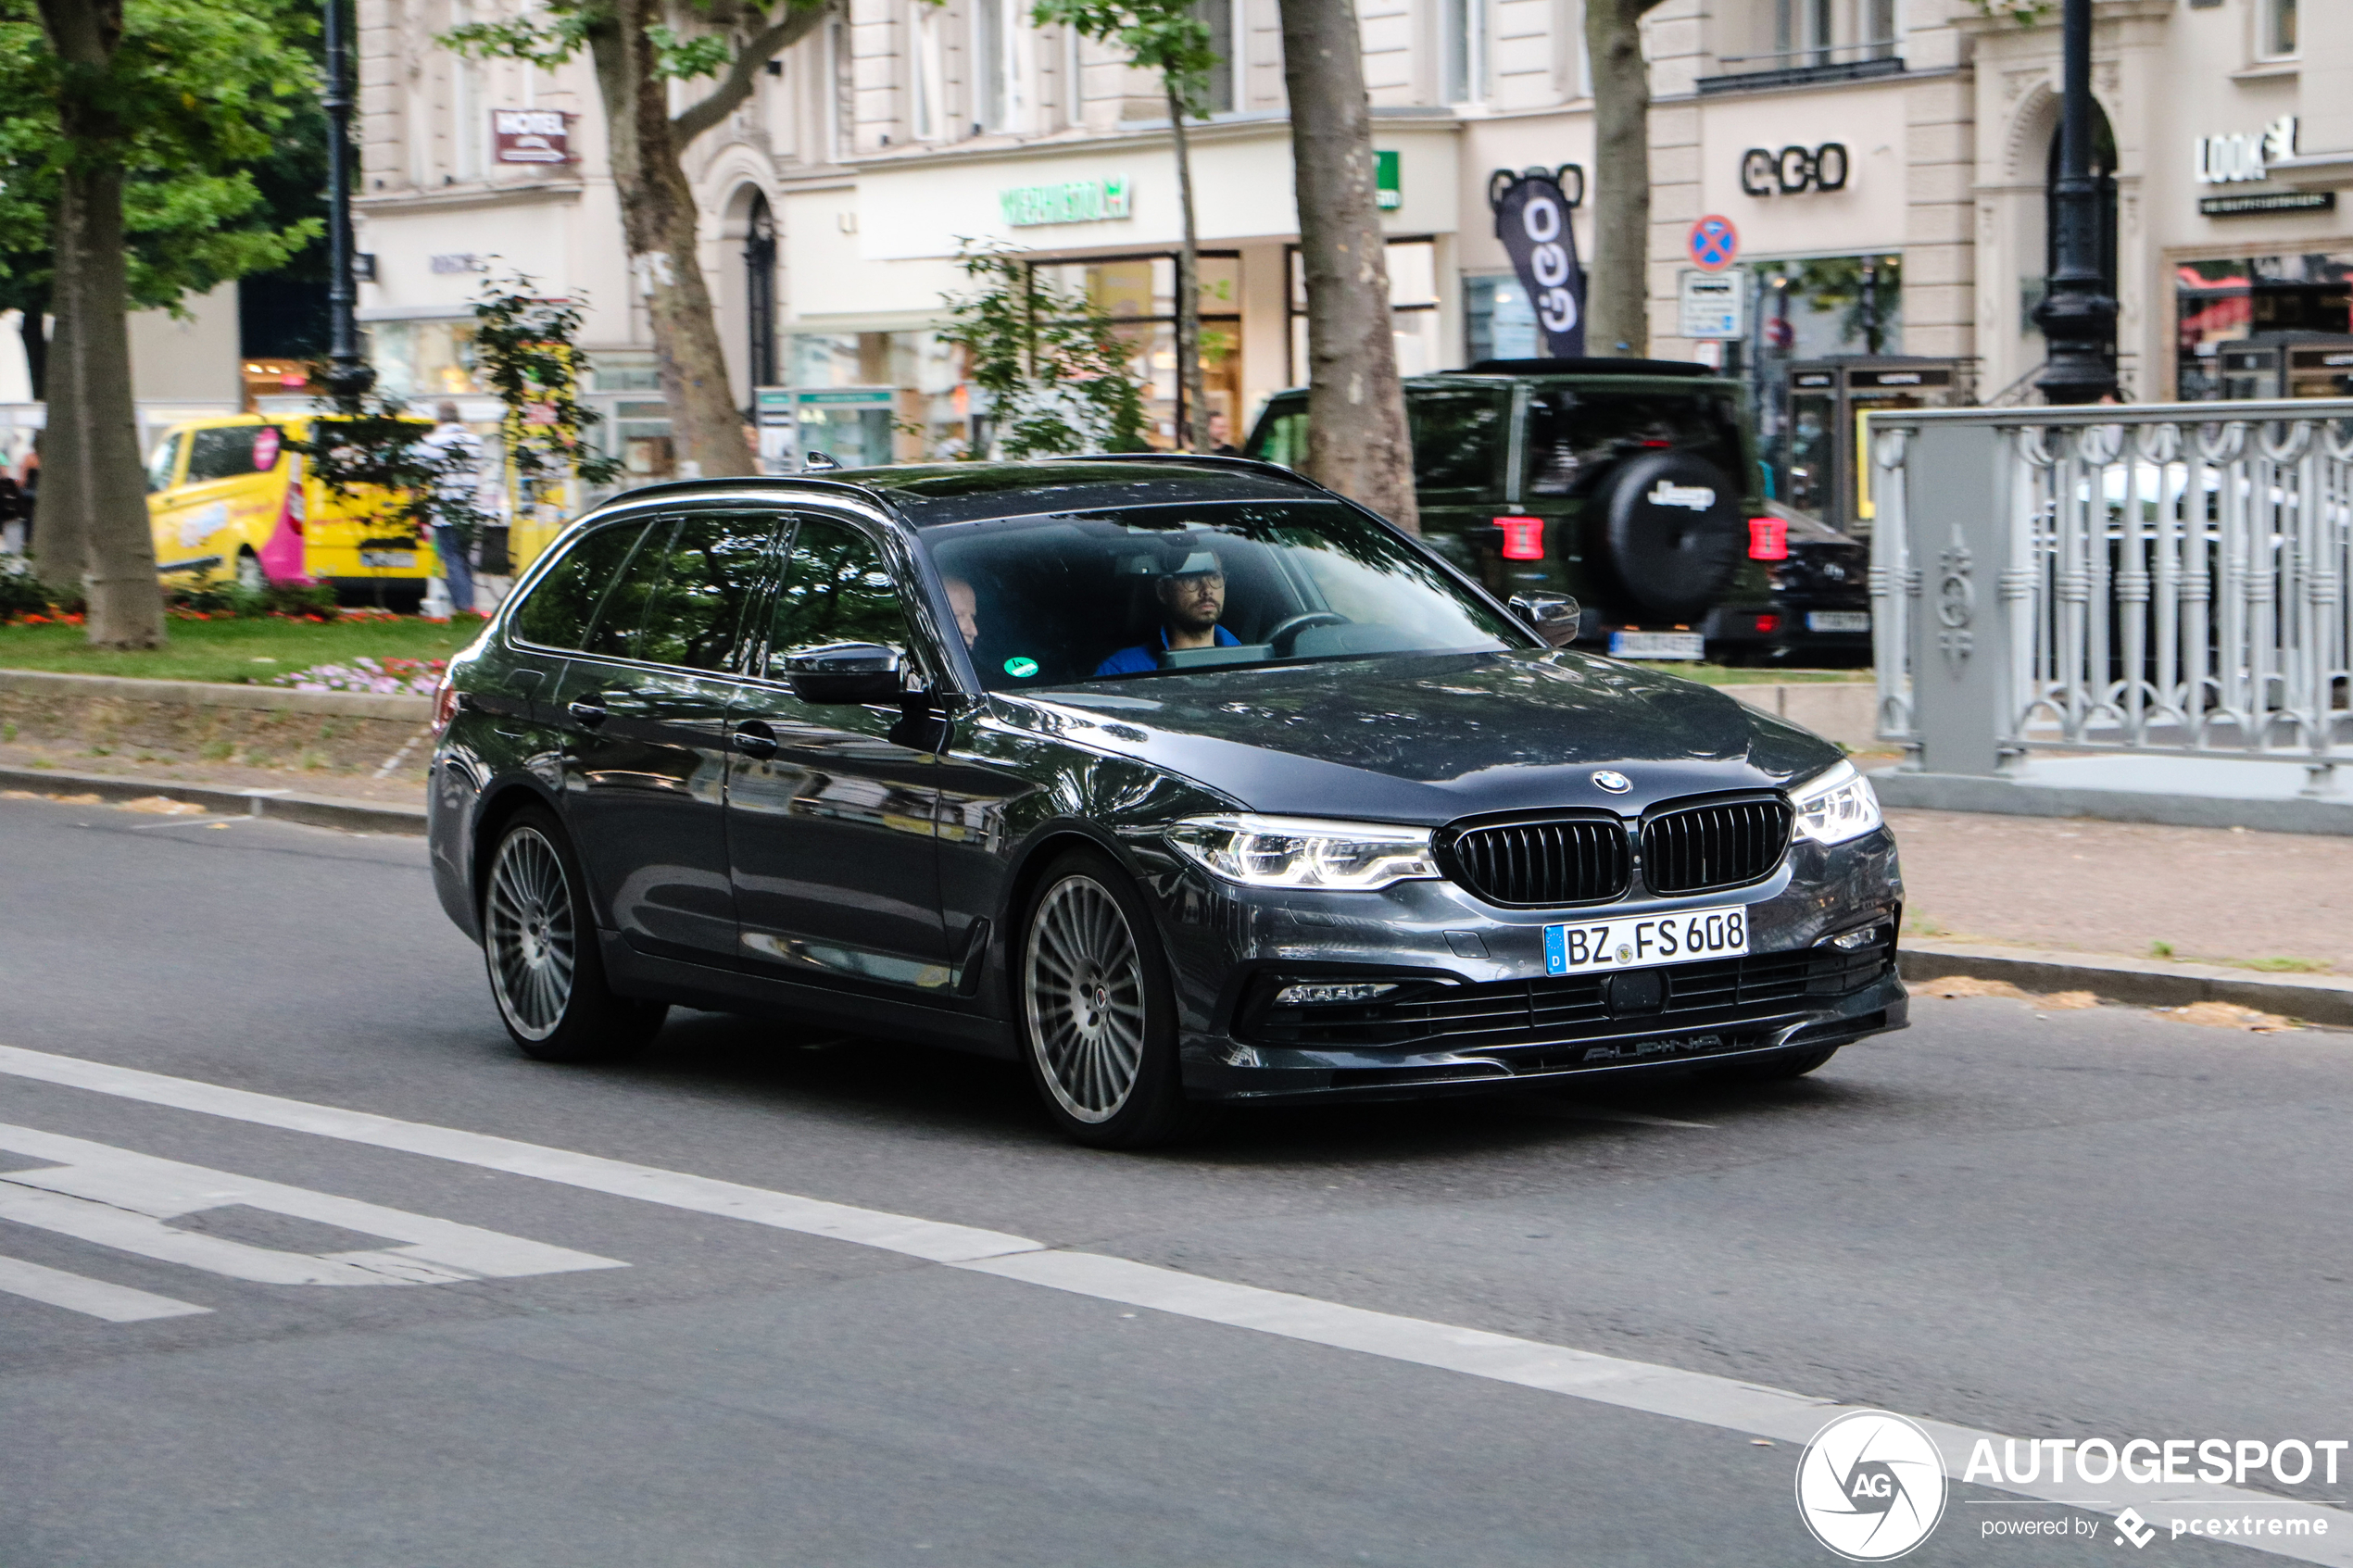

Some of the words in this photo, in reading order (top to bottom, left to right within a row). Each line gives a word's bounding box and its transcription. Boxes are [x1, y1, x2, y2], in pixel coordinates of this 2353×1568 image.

[1647, 479, 1716, 511] Jeep
[1567, 926, 1613, 966] BZ
[1635, 919, 1678, 960] FS
[1686, 912, 1745, 953] 608
[1582, 1034, 1724, 1061] ALPINA
